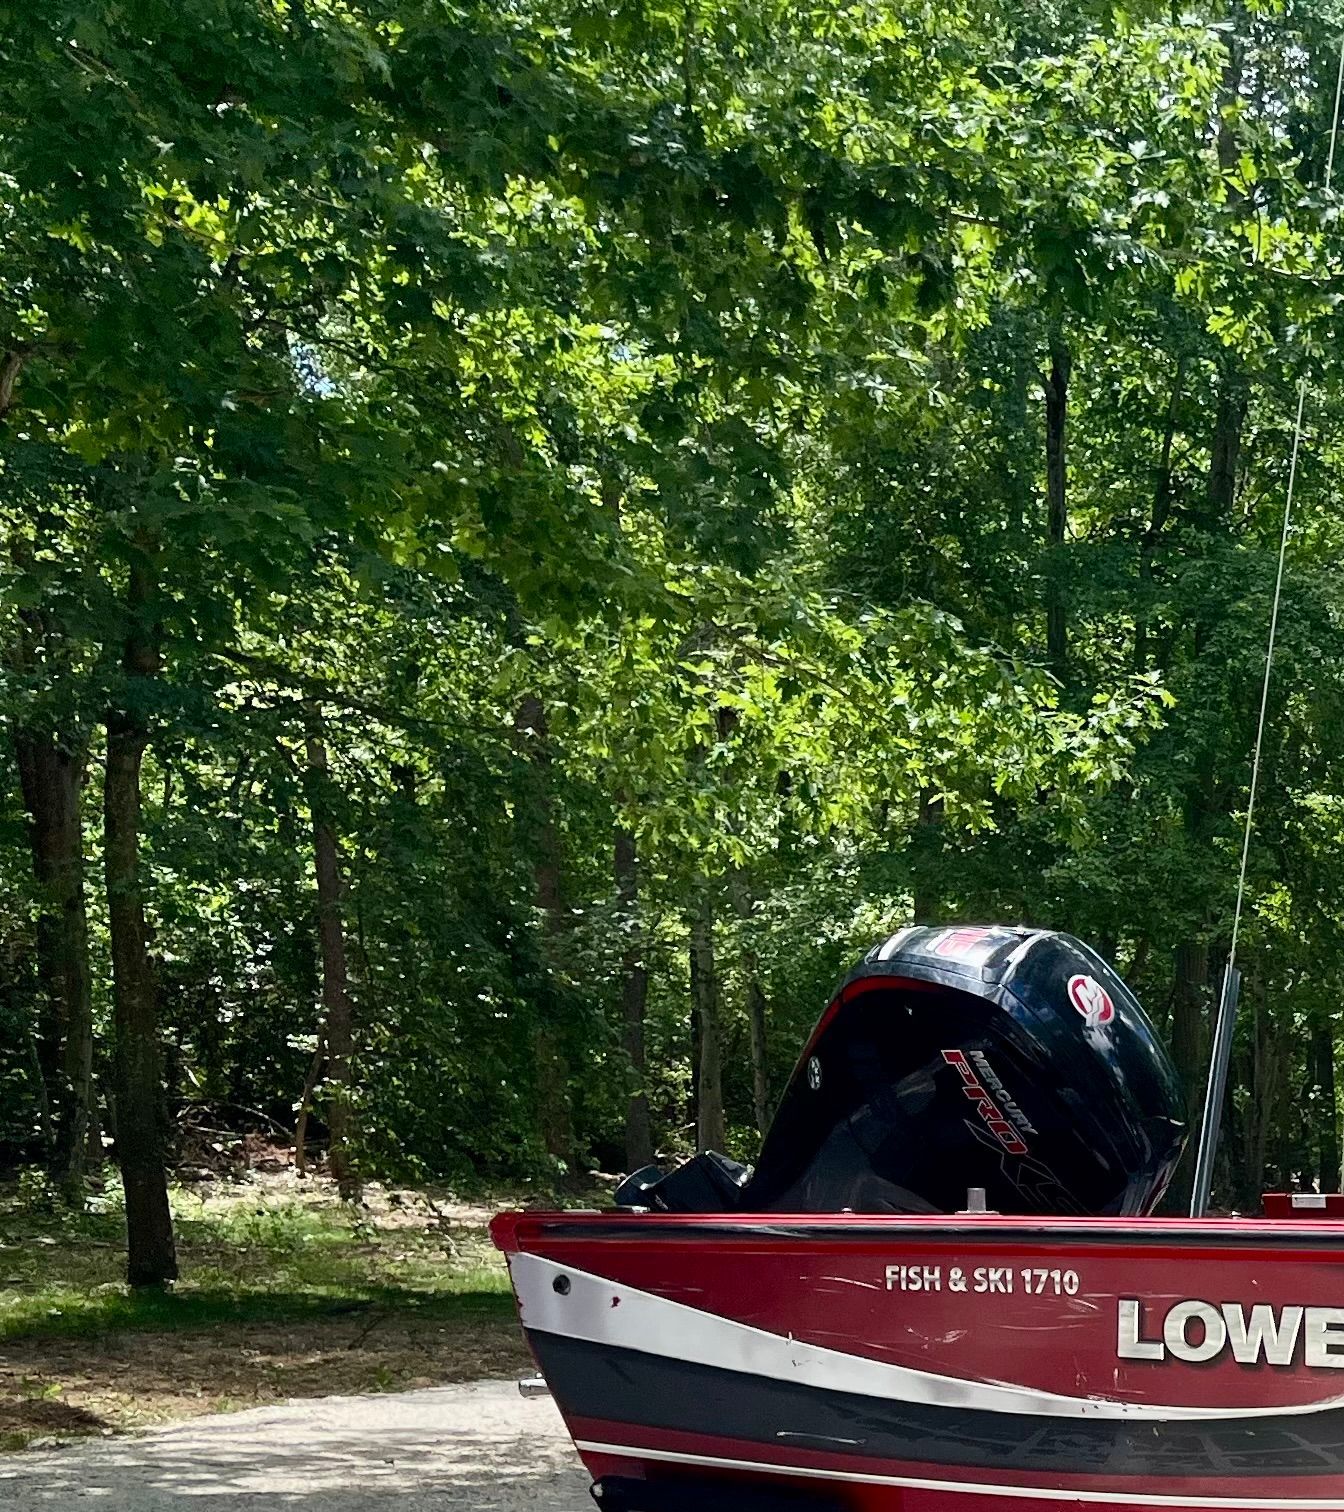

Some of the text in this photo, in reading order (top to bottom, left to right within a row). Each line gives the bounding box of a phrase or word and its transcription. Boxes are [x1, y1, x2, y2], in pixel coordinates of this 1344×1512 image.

[941, 1049, 1028, 1154] PRO
[969, 1050, 1039, 1135] MERCURY
[885, 1265, 1080, 1296] FISH & SKI 1710
